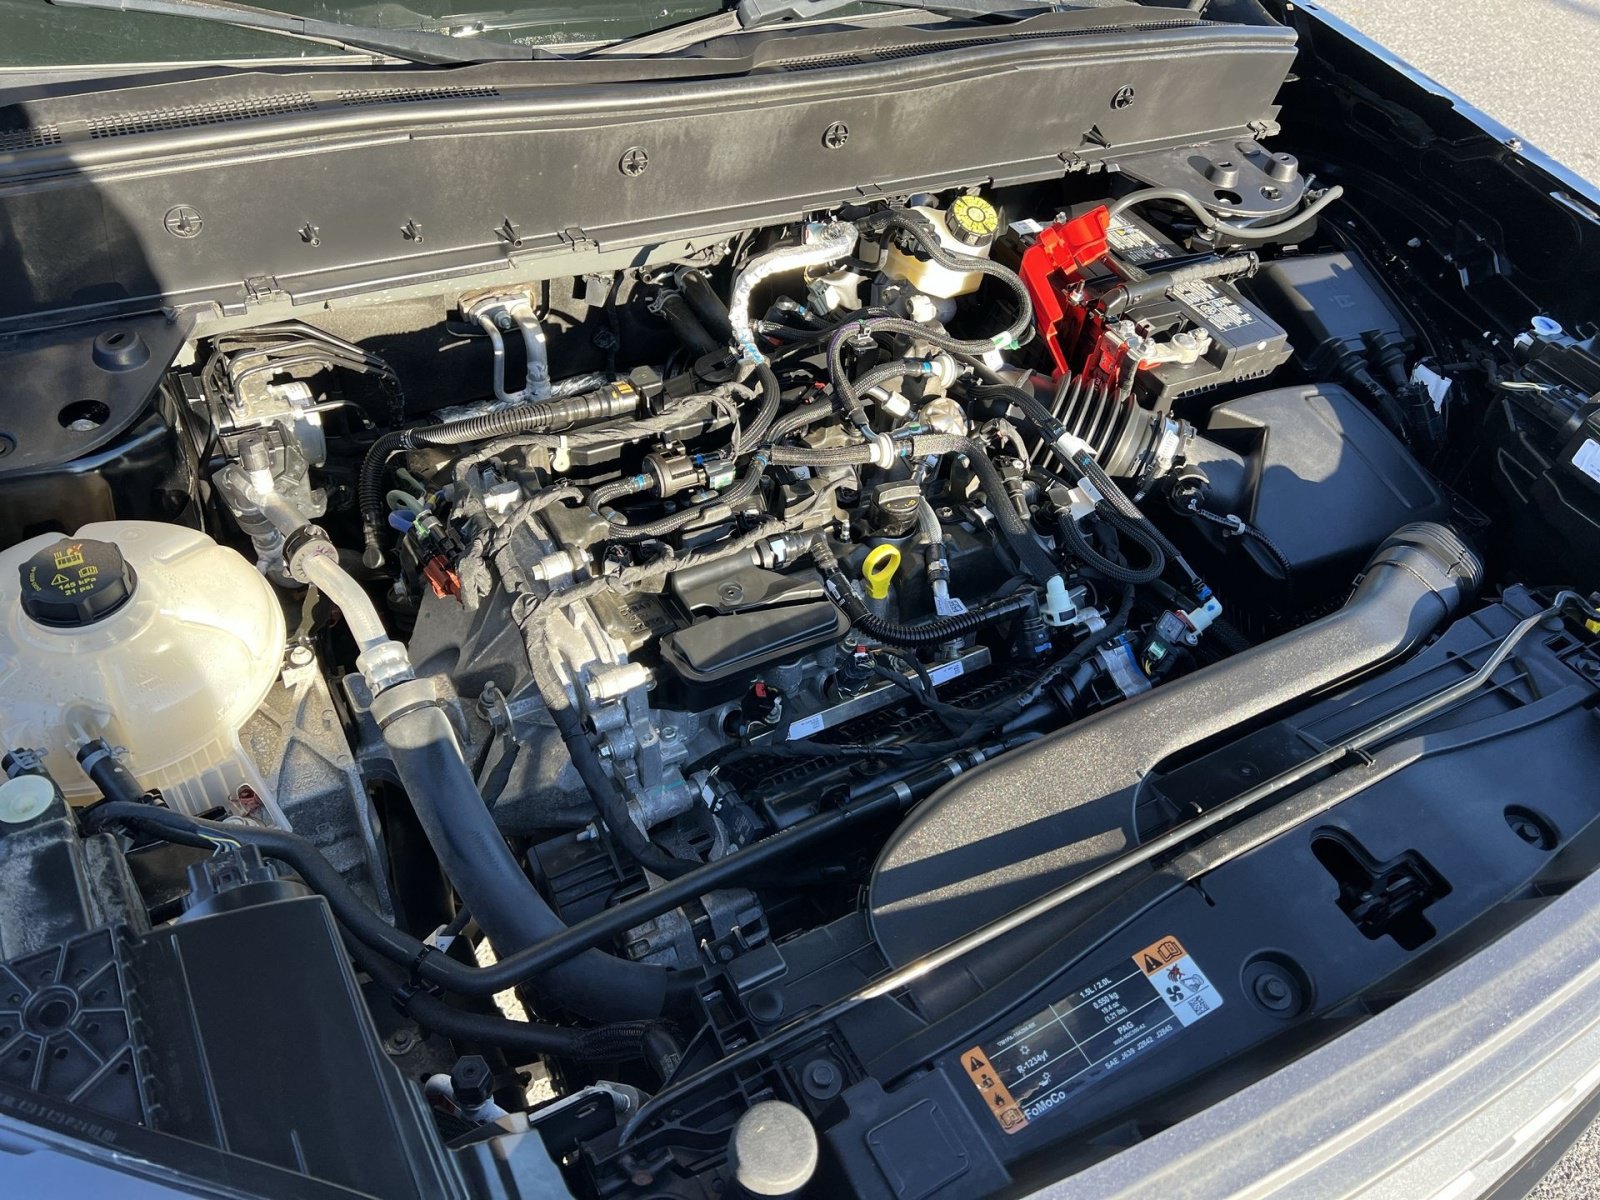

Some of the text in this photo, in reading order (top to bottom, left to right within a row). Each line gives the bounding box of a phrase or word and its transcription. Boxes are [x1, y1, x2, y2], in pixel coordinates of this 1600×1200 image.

[58, 577, 97, 591] 145 kPa
[64, 583, 94, 596] 21 psi
[1080, 987, 1095, 998] 1.5L
[1096, 978, 1112, 989] 2.0L
[1092, 991, 1120, 1009] 0.550 kg
[1117, 1021, 1134, 1035] PAG
[1104, 1057, 1120, 1070] SAE
[1121, 1047, 1136, 1060] J639
[1156, 1024, 1173, 1039] J2845
[1016, 1050, 1049, 1074] R-1234yf
[1024, 1091, 1066, 1120] FoMoCo
